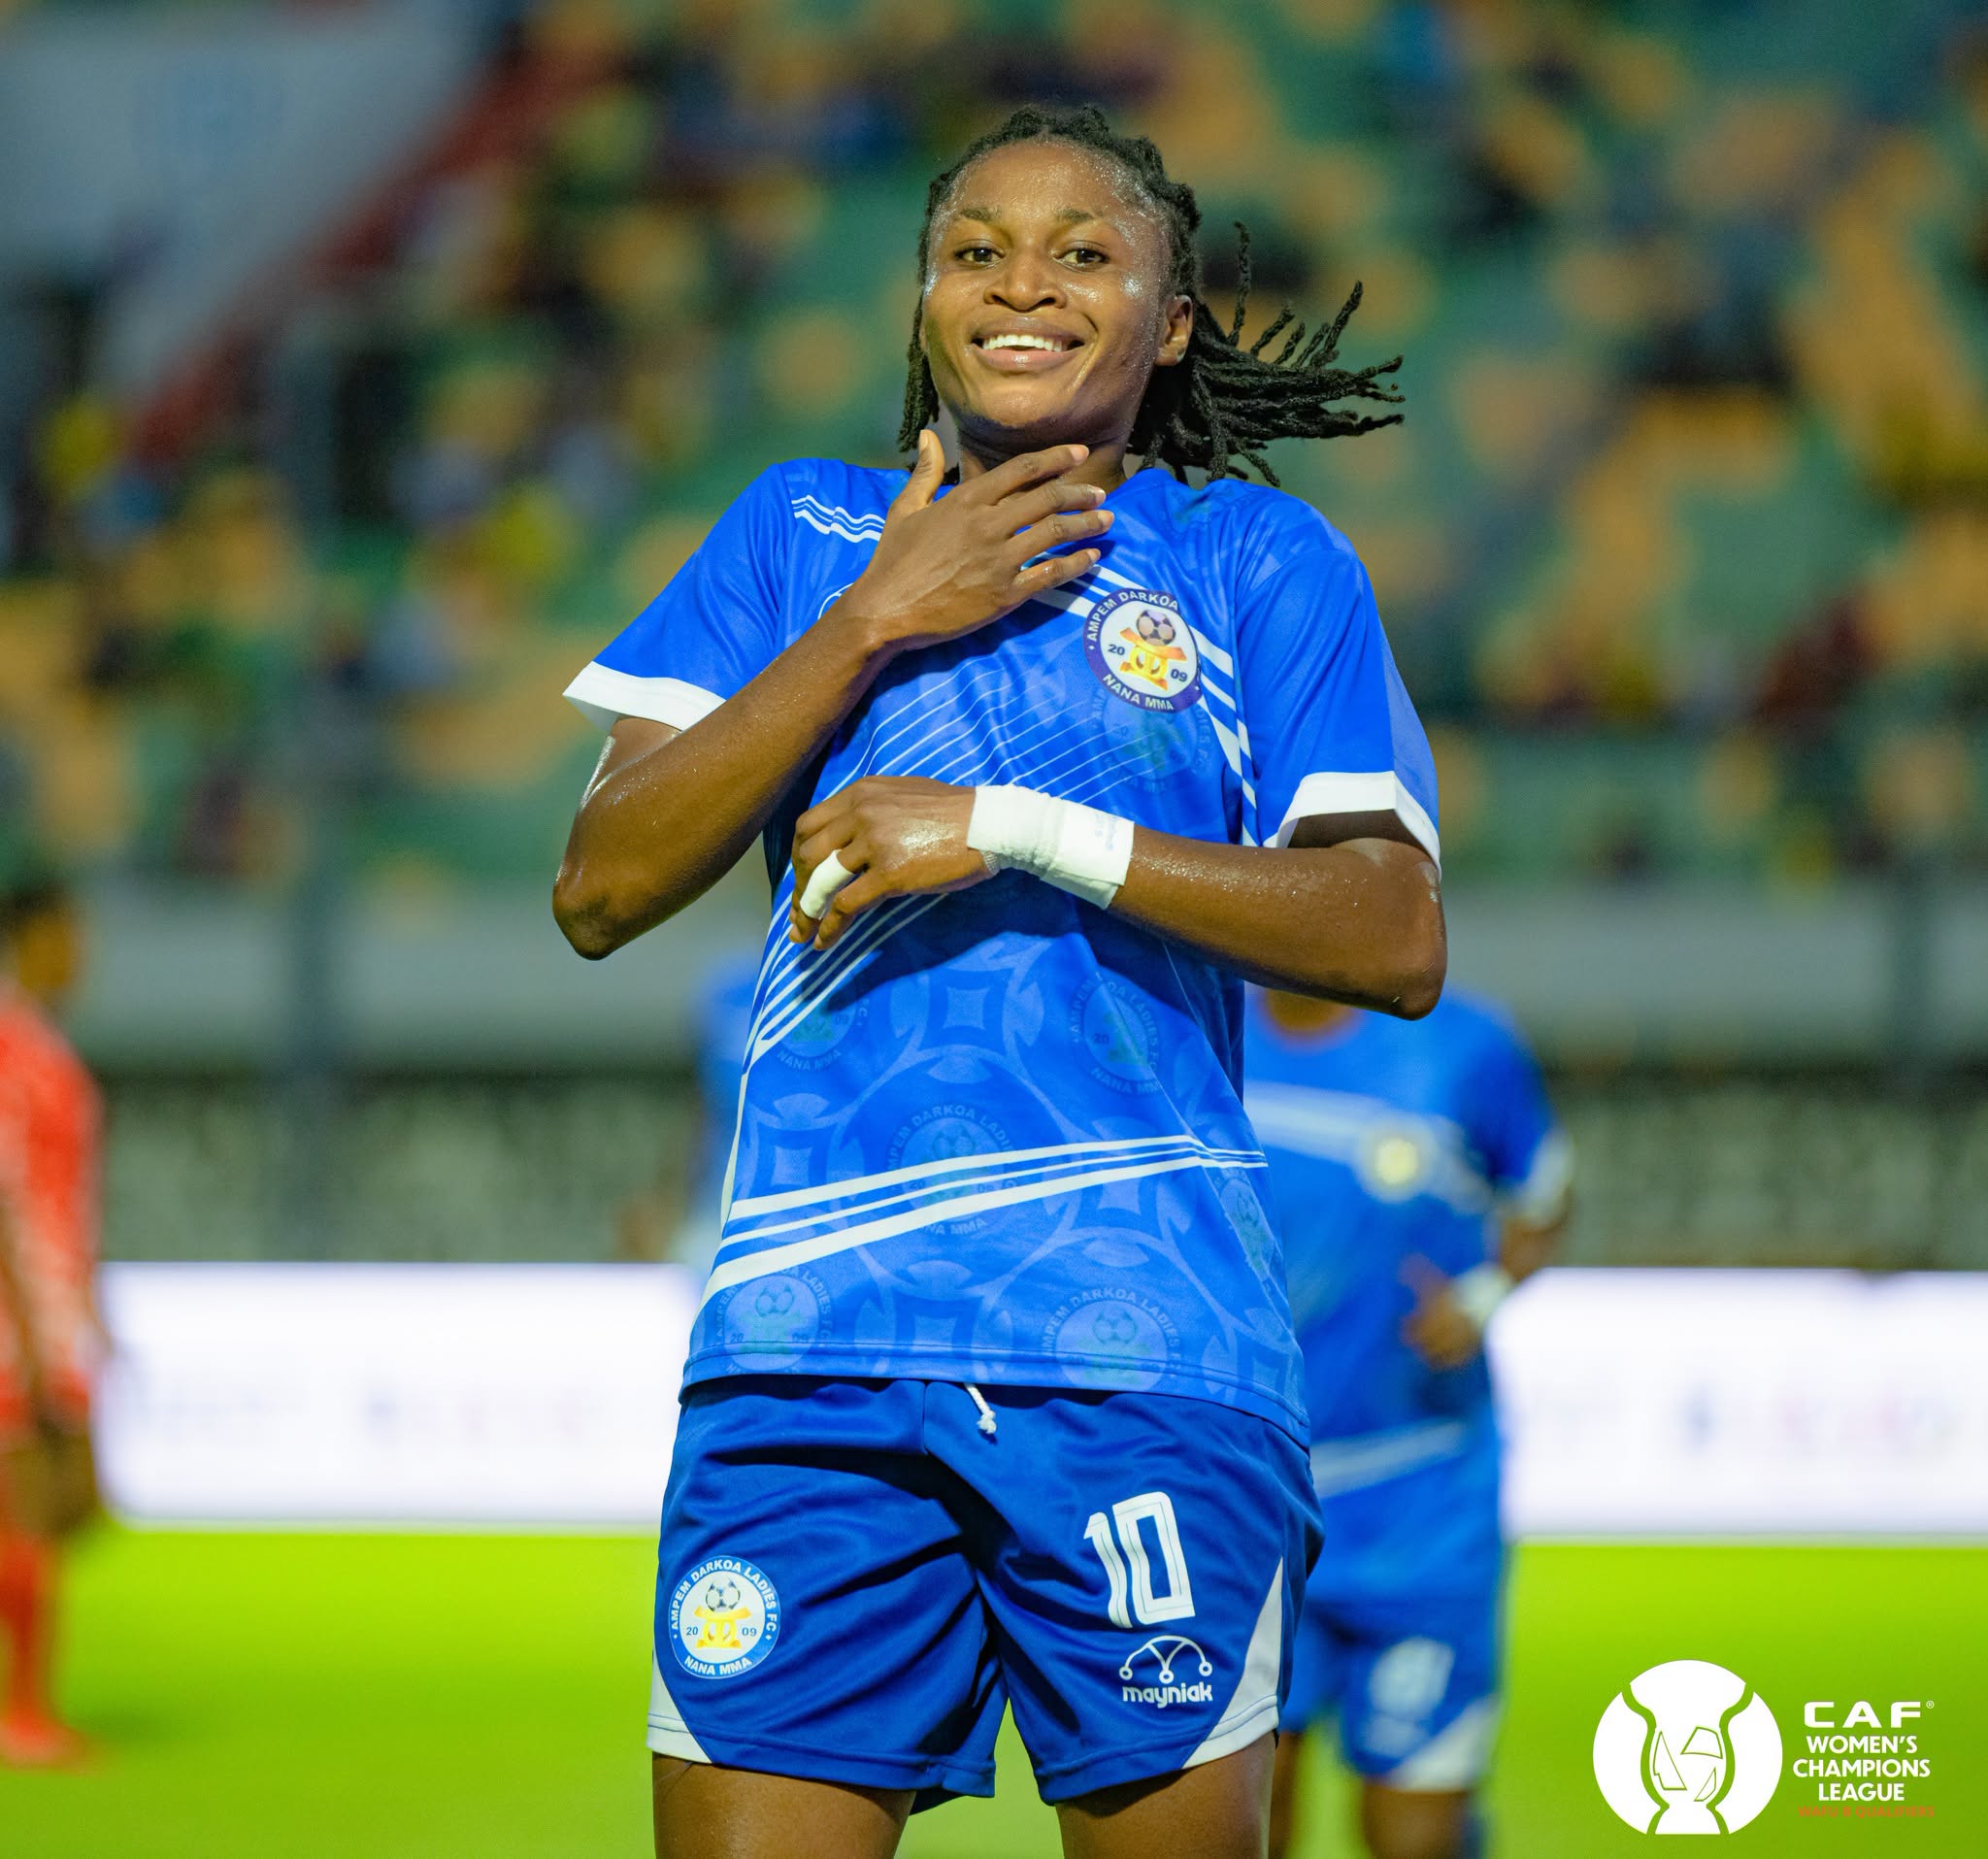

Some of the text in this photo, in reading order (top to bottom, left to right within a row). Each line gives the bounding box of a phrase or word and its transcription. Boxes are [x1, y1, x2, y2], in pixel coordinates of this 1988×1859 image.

[1086, 590, 1178, 643] AMPEM DARKOA
[1108, 644, 1188, 682] 20 09
[1103, 674, 1175, 711] NANA MMA
[887, 1126, 911, 1170] MPEM
[911, 1104, 976, 1126] DARKOA
[1070, 1287, 1138, 1308] DARKOA
[1083, 1491, 1196, 1628] 10
[671, 1559, 778, 1633] AMPEM DARKOA LADIES FC
[685, 1626, 757, 1637] 20 09
[684, 1655, 753, 1676] NANA MMA
[1122, 1681, 1213, 1709] mayniak
